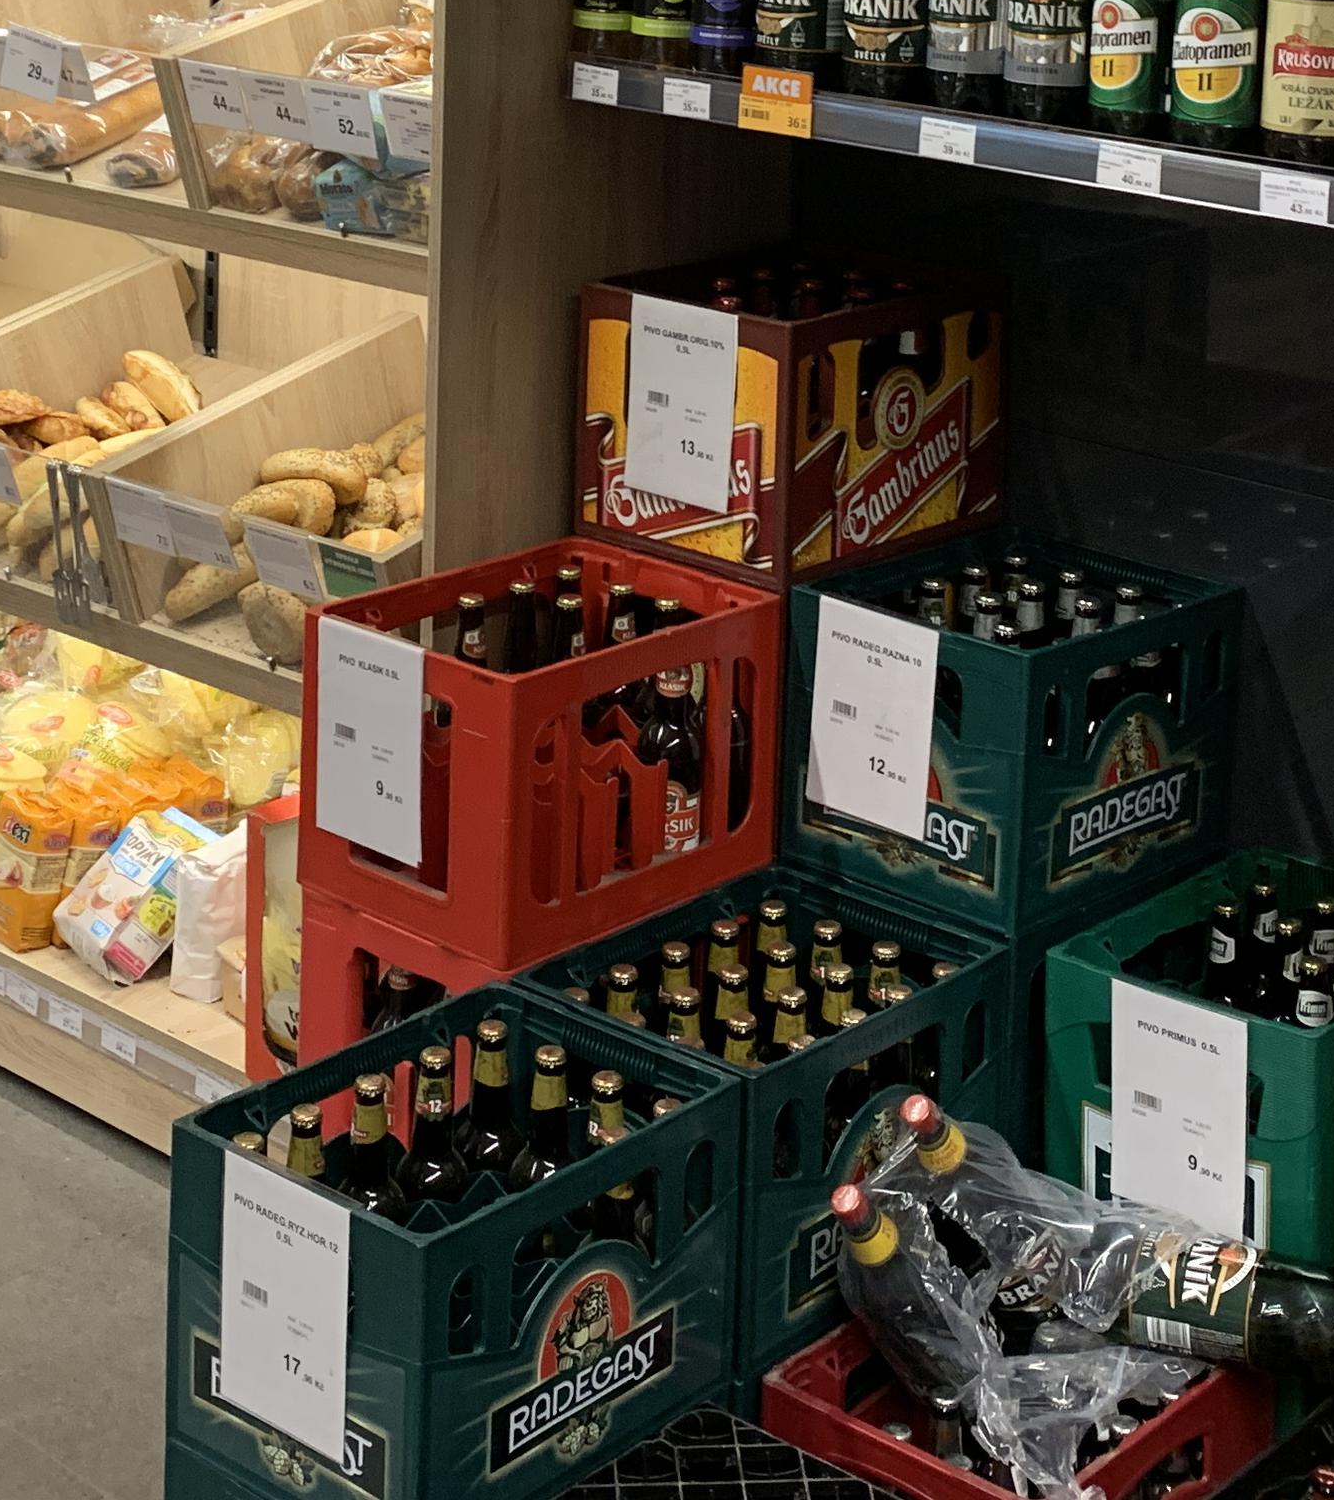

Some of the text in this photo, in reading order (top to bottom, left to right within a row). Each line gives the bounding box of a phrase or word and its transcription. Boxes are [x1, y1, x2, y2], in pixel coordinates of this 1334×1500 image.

[1008, 1, 1082, 28] BRANÍK
[26, 61, 43, 81] 29
[1102, 59, 1113, 77] 11
[751, 74, 802, 99] AKCE
[1197, 73, 1213, 91] 11
[1287, 95, 1334, 112] LEŽÁK
[338, 117, 356, 137] 52
[786, 115, 801, 129] 36
[681, 439, 695, 455] 13
[841, 418, 962, 545] Gambrinus
[831, 631, 851, 644] PIVO
[358, 659, 384, 675] KLASIK
[869, 756, 885, 775] 12
[375, 780, 384, 797] 9
[1069, 772, 1186, 856] RADEGAST
[1137, 1019, 1198, 1047] PIVO PRIMUS
[428, 1097, 443, 1113] 12
[1187, 1154, 1198, 1171] 9
[234, 1193, 254, 1210] PIVO
[284, 1354, 301, 1375] 17
[507, 1322, 665, 1457] RADEGAST
